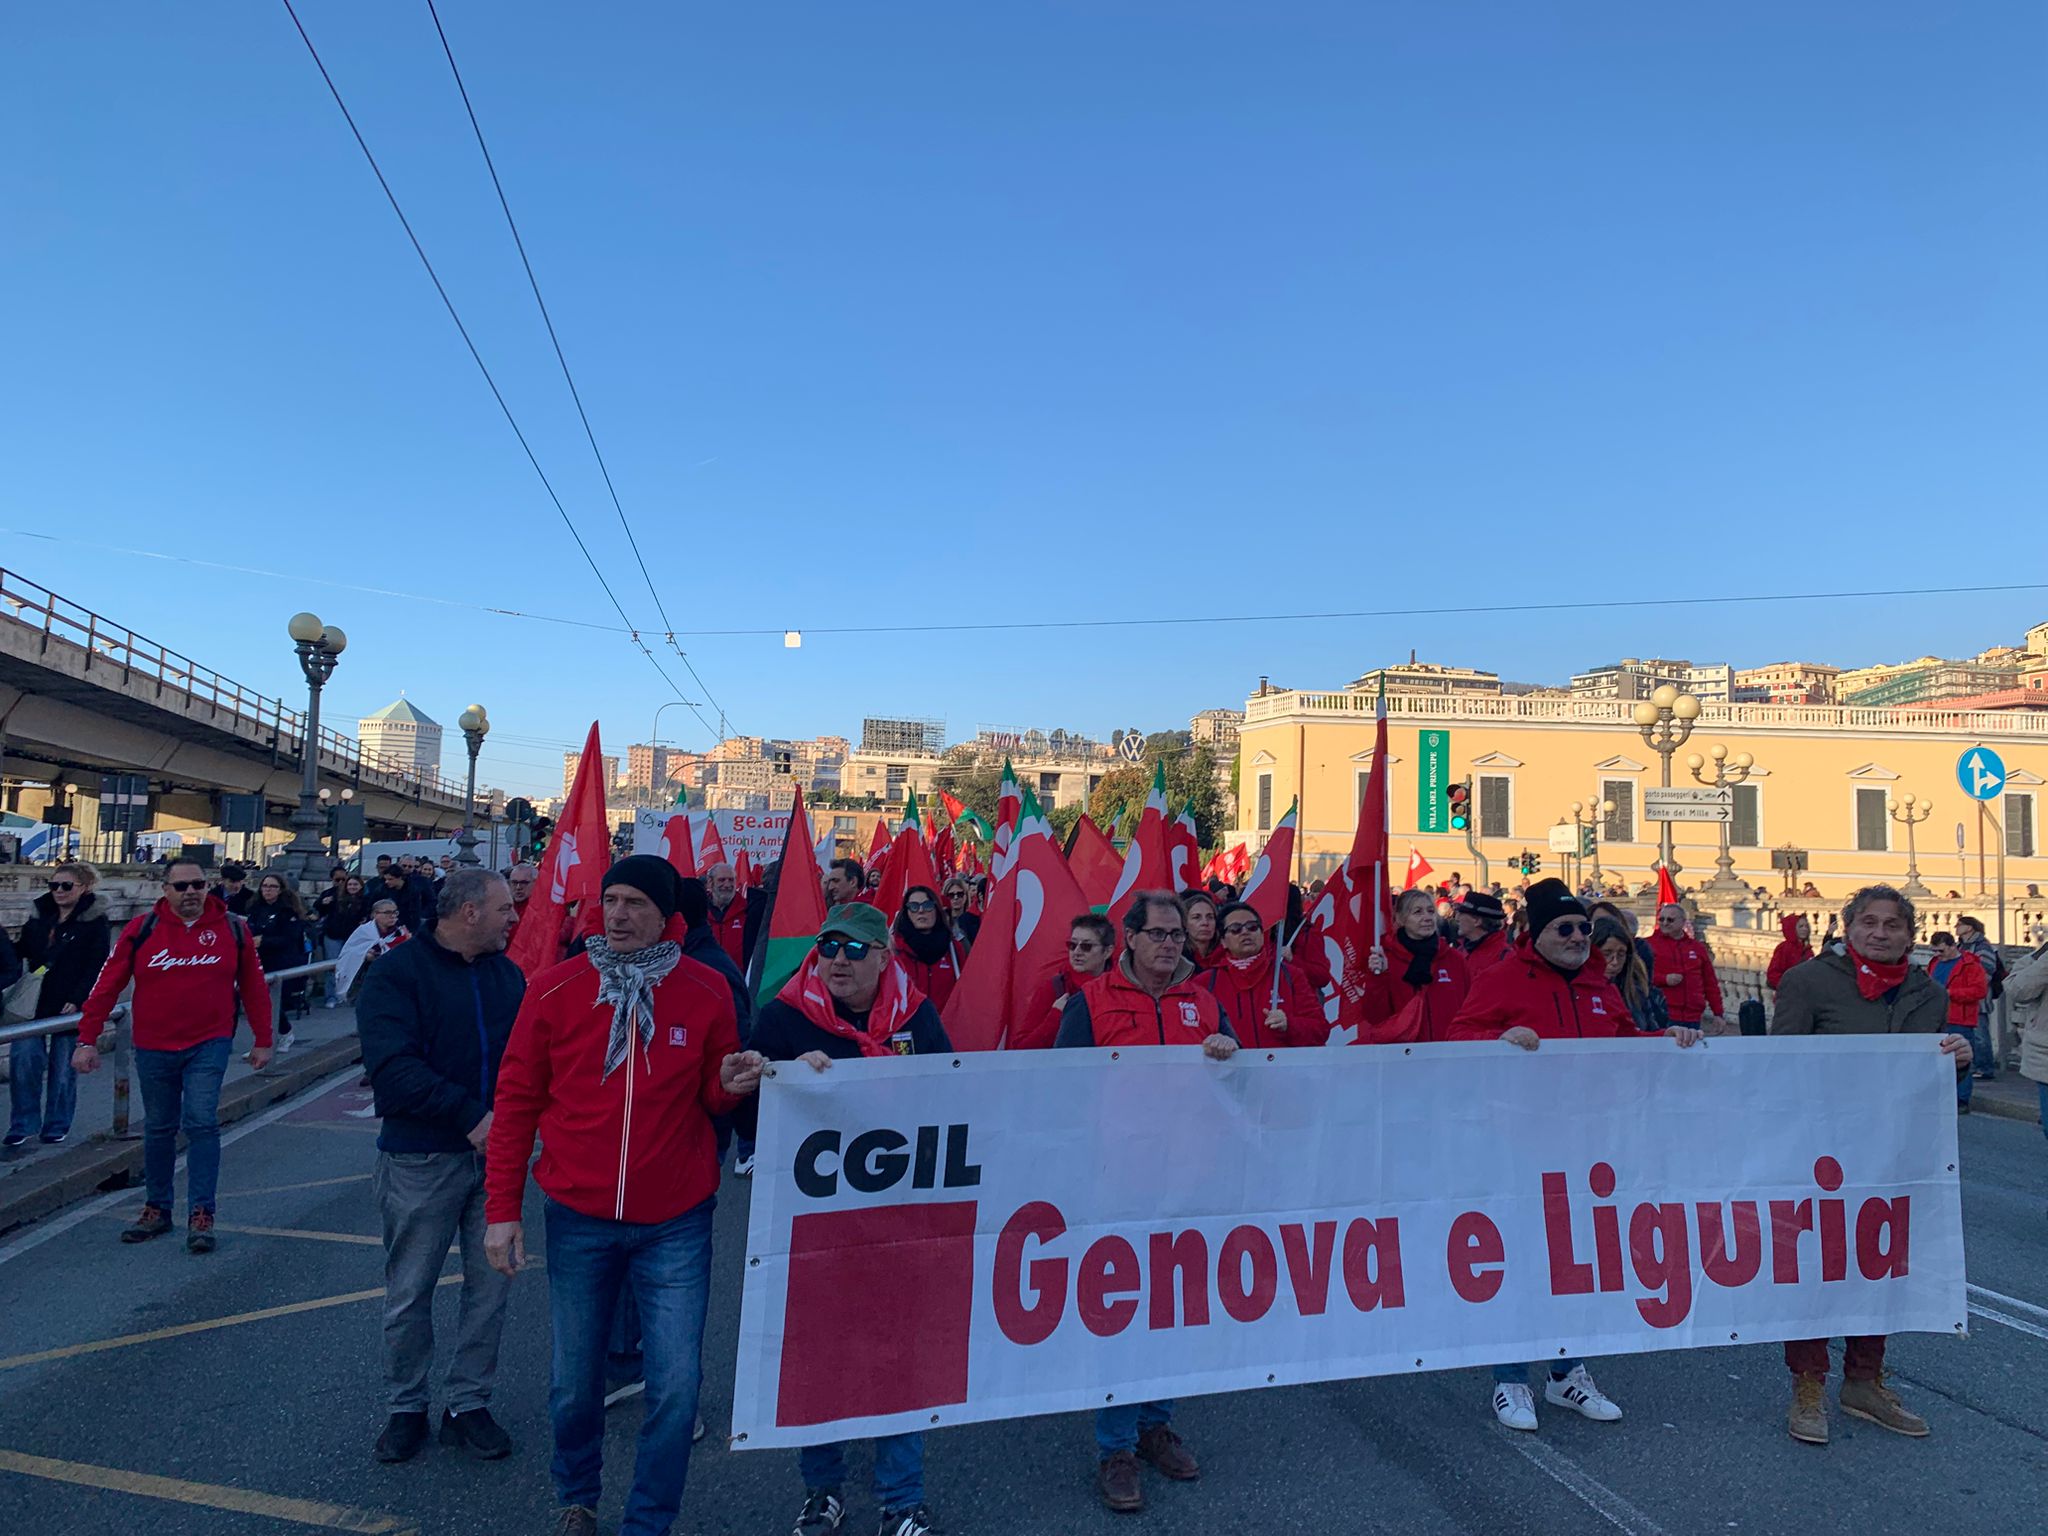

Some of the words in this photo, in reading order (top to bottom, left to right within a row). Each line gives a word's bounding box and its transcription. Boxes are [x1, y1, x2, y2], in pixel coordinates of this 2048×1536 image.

[1429, 752, 1438, 788] PRINCIPE
[1429, 789, 1437, 805] DEL
[1660, 790, 1690, 800] passeggeri
[1429, 806, 1437, 829] VILLA
[1647, 808, 1670, 817] Ponte
[1689, 808, 1709, 817] Mille
[147, 948, 222, 971] Liguria
[793, 1123, 982, 1198] CGIL
[992, 1200, 1406, 1346] Genova
[1447, 1211, 1505, 1304] e
[1541, 1155, 1911, 1329] Liguria
